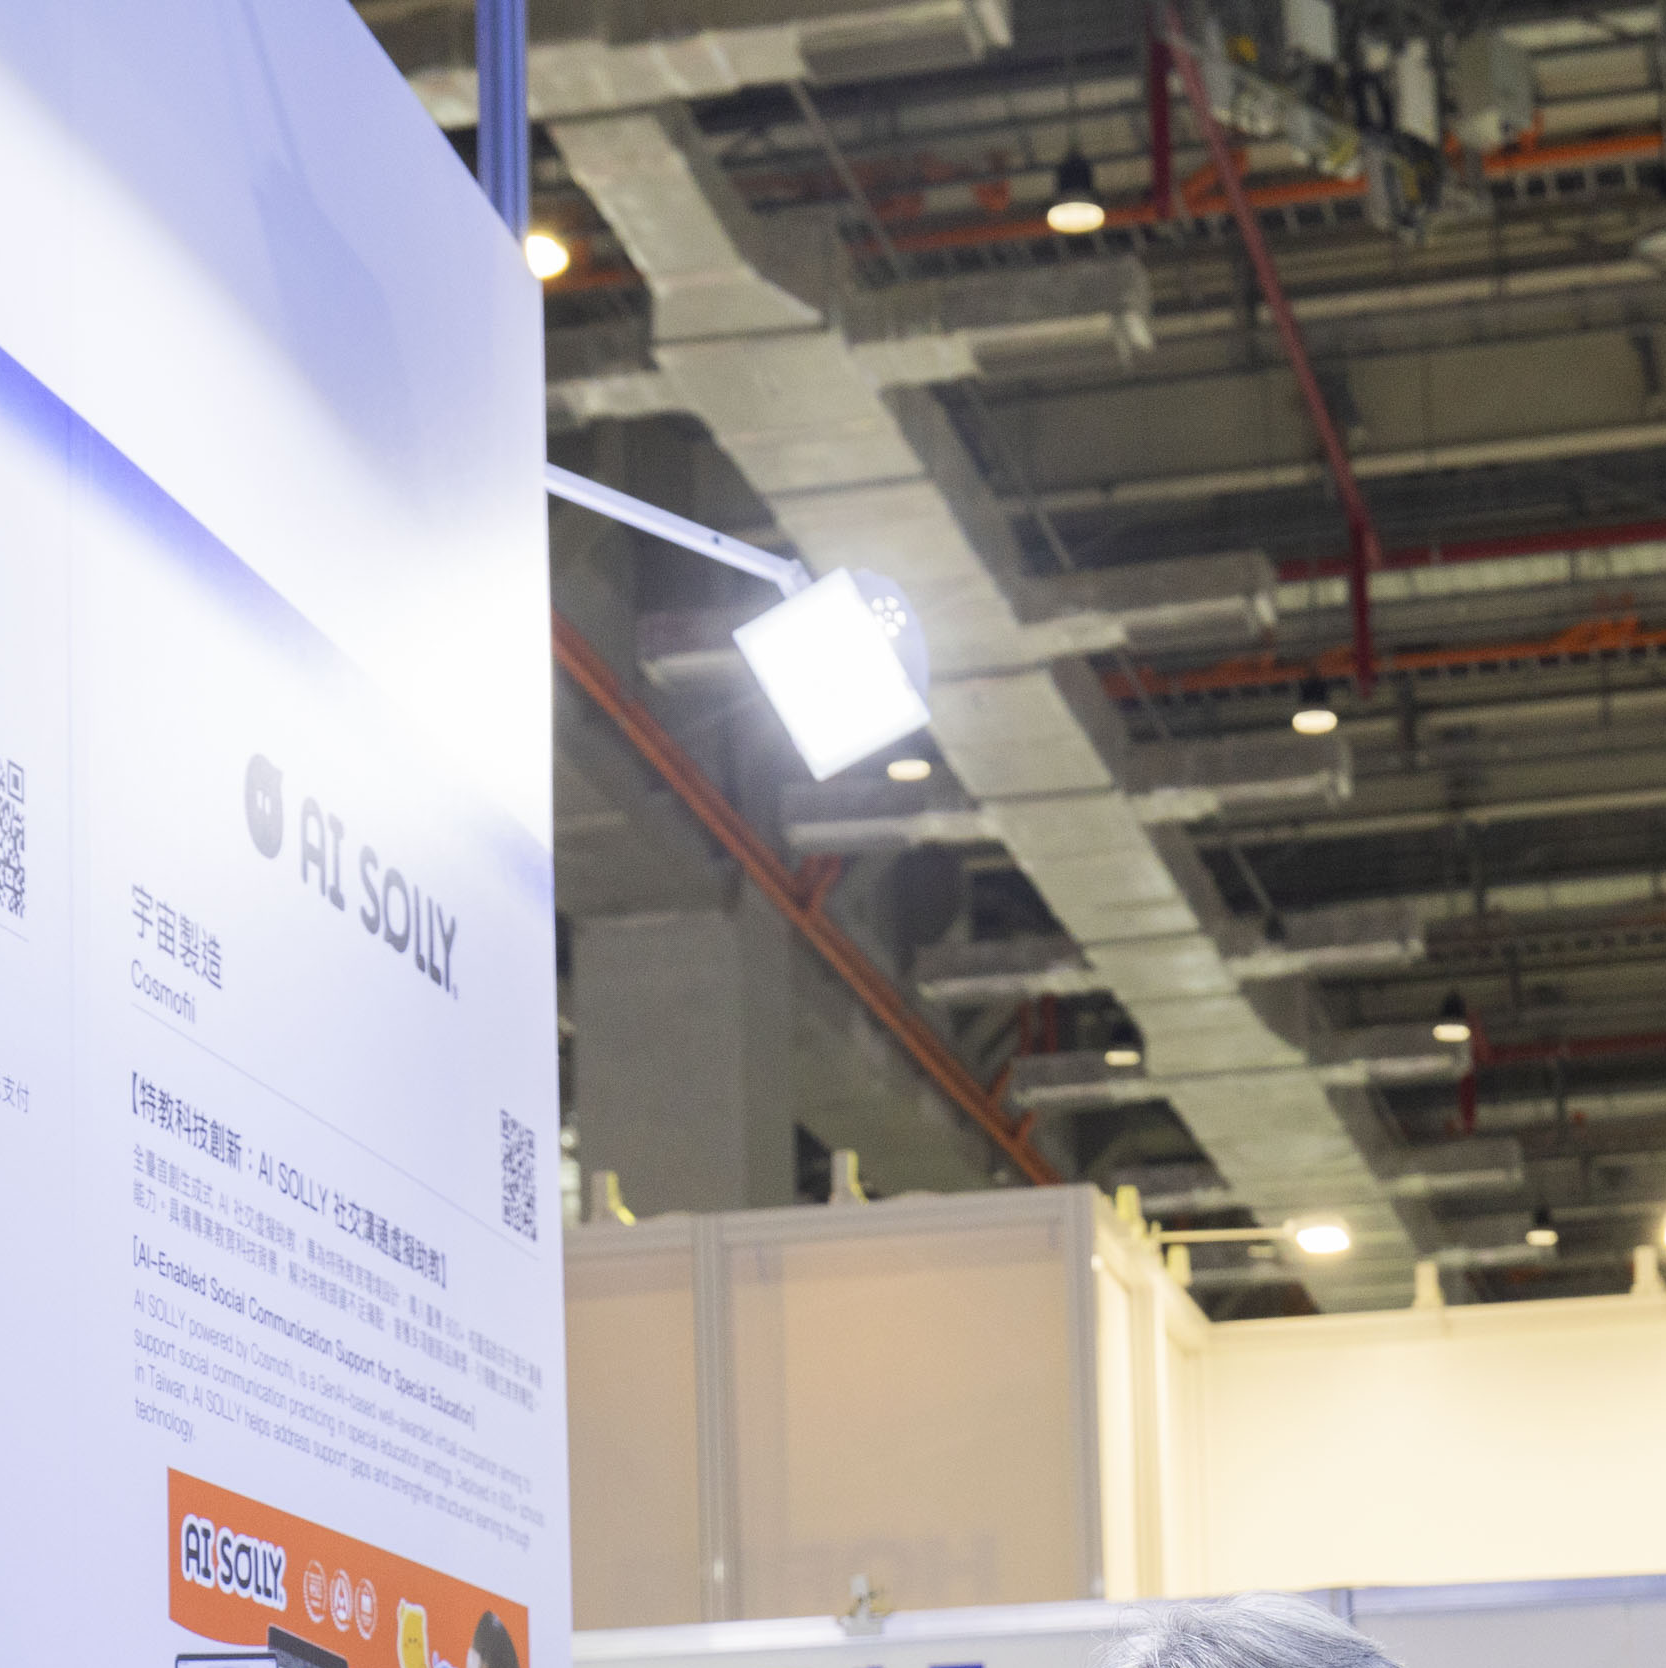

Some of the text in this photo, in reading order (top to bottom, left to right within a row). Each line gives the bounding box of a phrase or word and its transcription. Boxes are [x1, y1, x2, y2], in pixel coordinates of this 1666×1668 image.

[301, 797, 457, 993] AI SOLLY
[210, 1277, 245, 1315] Social
[249, 1297, 332, 1356] Communication
[336, 1339, 375, 1377] Support
[184, 1520, 284, 1602] AI SOLLY
